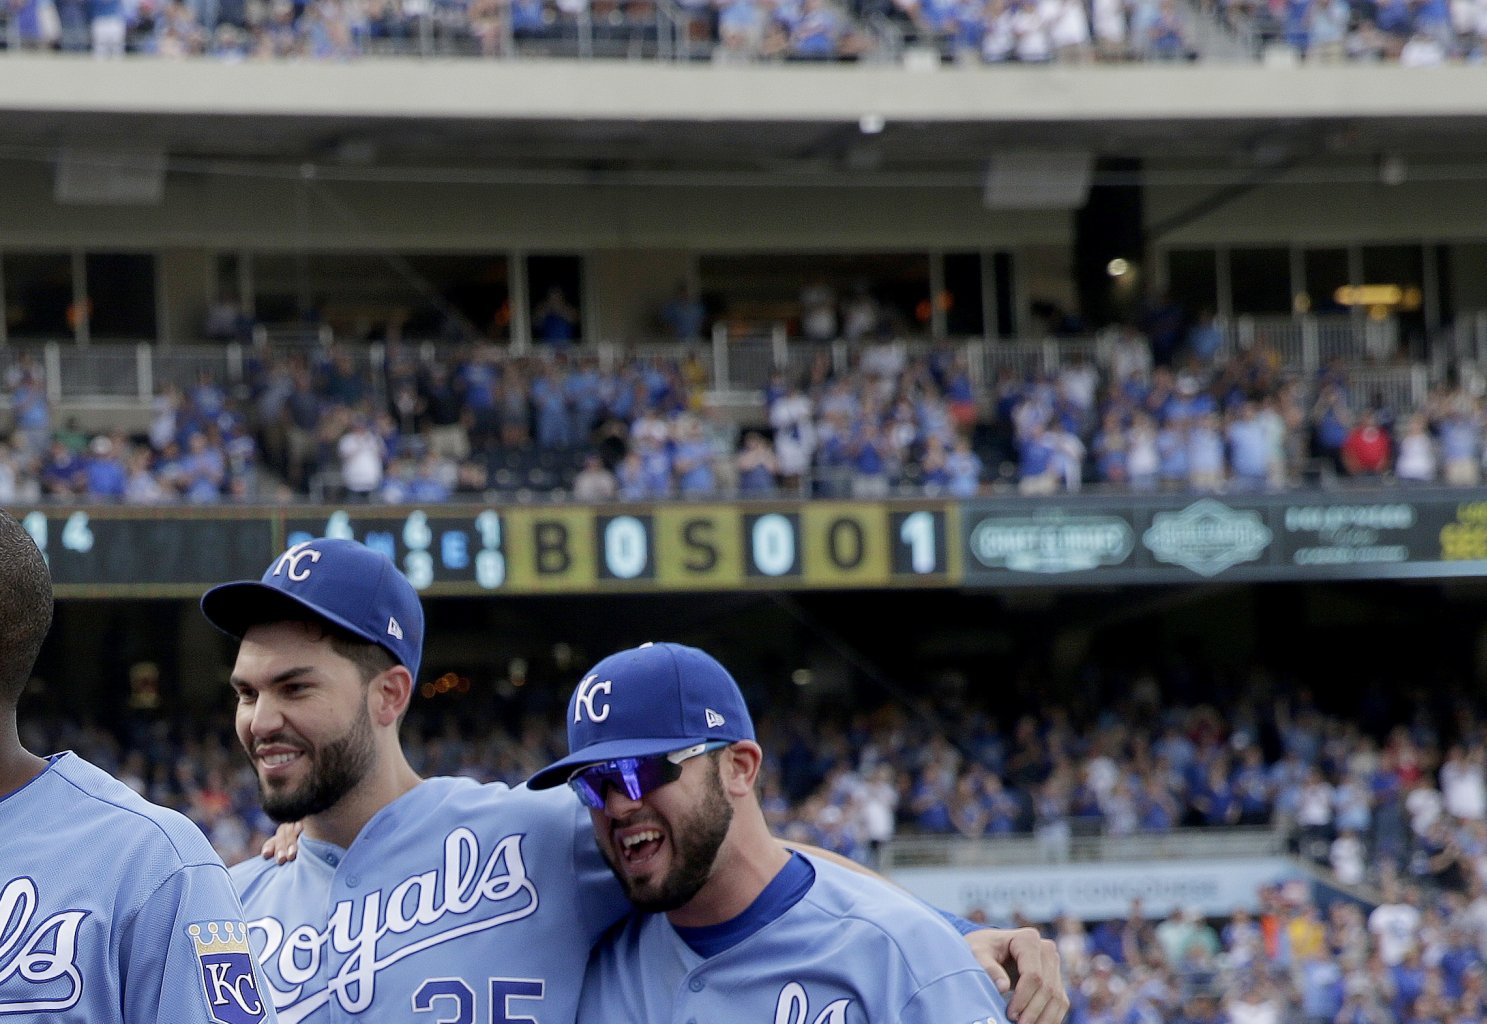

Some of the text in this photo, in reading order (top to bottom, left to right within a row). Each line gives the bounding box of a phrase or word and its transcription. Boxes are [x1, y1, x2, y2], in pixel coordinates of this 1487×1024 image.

[273, 541, 321, 582] KC
[533, 520, 570, 575] B
[605, 515, 647, 578] 0
[680, 519, 718, 572] S
[752, 512, 795, 576] 0
[900, 510, 936, 575] 1
[573, 673, 612, 724] KC
[205, 962, 262, 1015] KC
